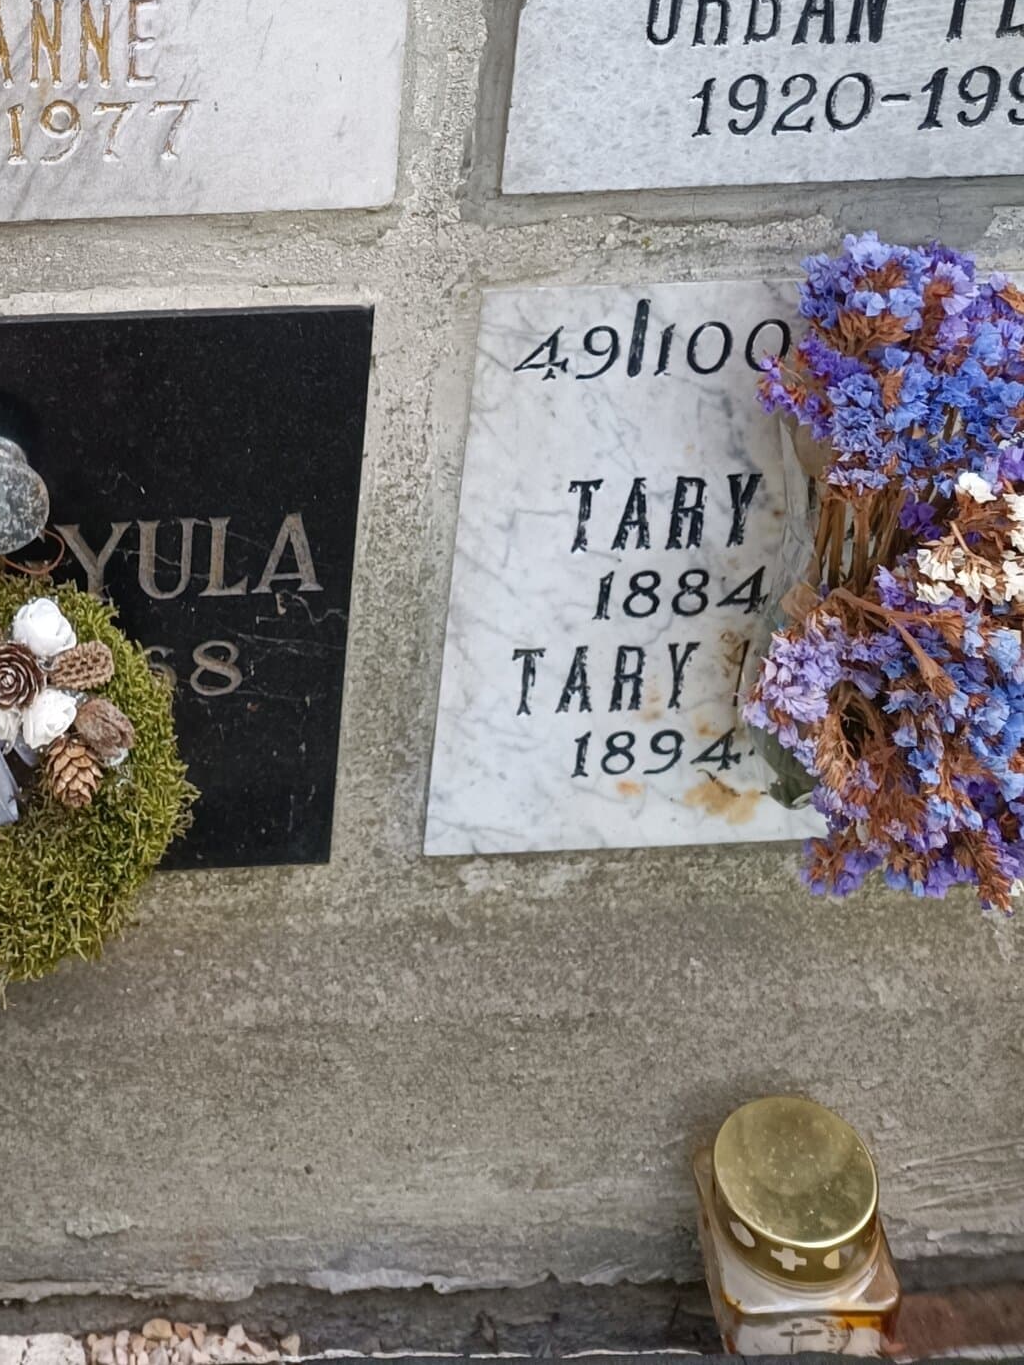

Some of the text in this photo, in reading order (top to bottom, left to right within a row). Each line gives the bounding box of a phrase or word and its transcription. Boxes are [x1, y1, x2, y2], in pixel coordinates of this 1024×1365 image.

[568, 472, 763, 554] TARY
[511, 640, 701, 716] TARY
[571, 728, 756, 779] 1894
